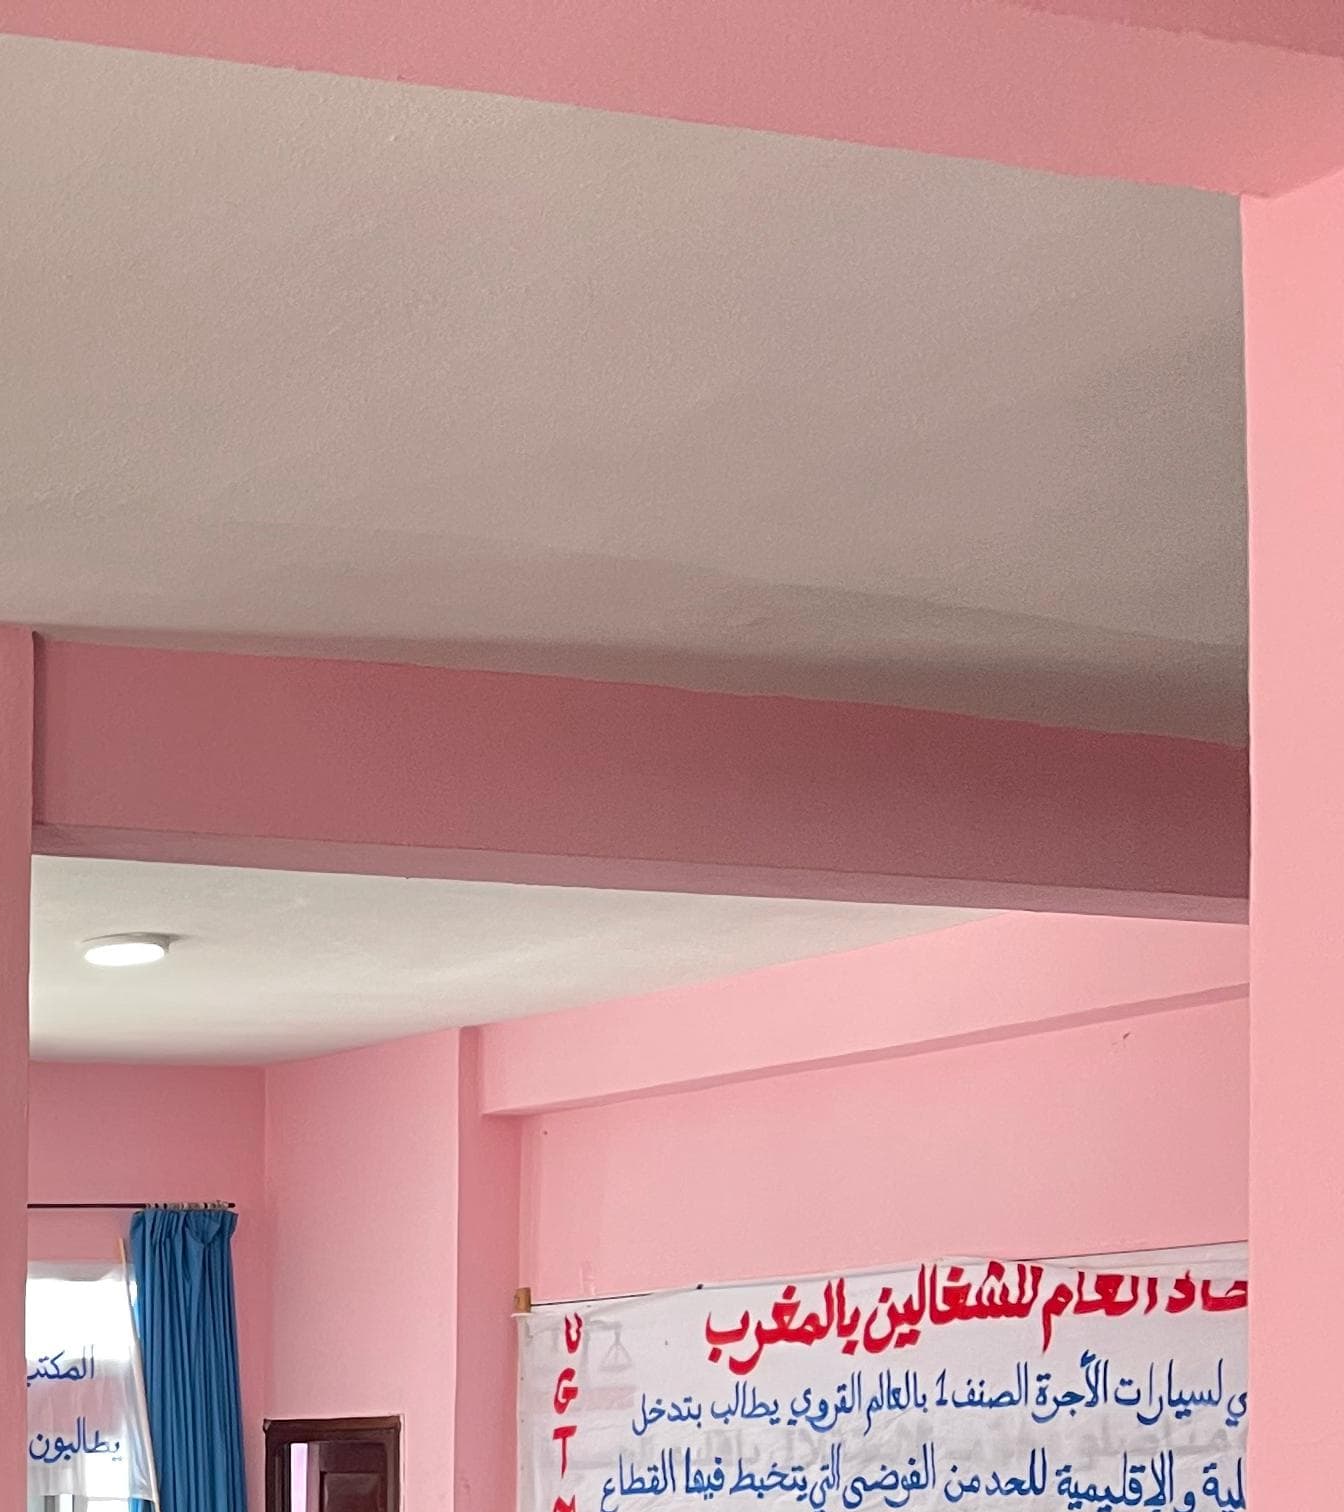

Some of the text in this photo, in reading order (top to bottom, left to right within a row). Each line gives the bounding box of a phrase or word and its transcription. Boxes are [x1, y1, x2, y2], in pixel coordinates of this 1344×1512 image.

[705, 1277, 862, 1375] بالمغرب
[864, 1261, 1043, 1354] للشغالين
[1042, 1271, 1158, 1354] العام
[711, 1380, 780, 1425] يطالب
[790, 1371, 863, 1434] القروي
[952, 1361, 1029, 1410] الصنف
[1032, 1349, 1109, 1424] الأجرة
[1114, 1358, 1224, 1426] لسيارات
[29, 1416, 122, 1463] يطالبون
[632, 1393, 703, 1436] بتدخل
[685, 1446, 726, 1501] فيها
[729, 1457, 808, 1502] يتخبط
[842, 1442, 937, 1510] الفوضى
[944, 1464, 982, 1503] من
[984, 1447, 1048, 1497] للحد
